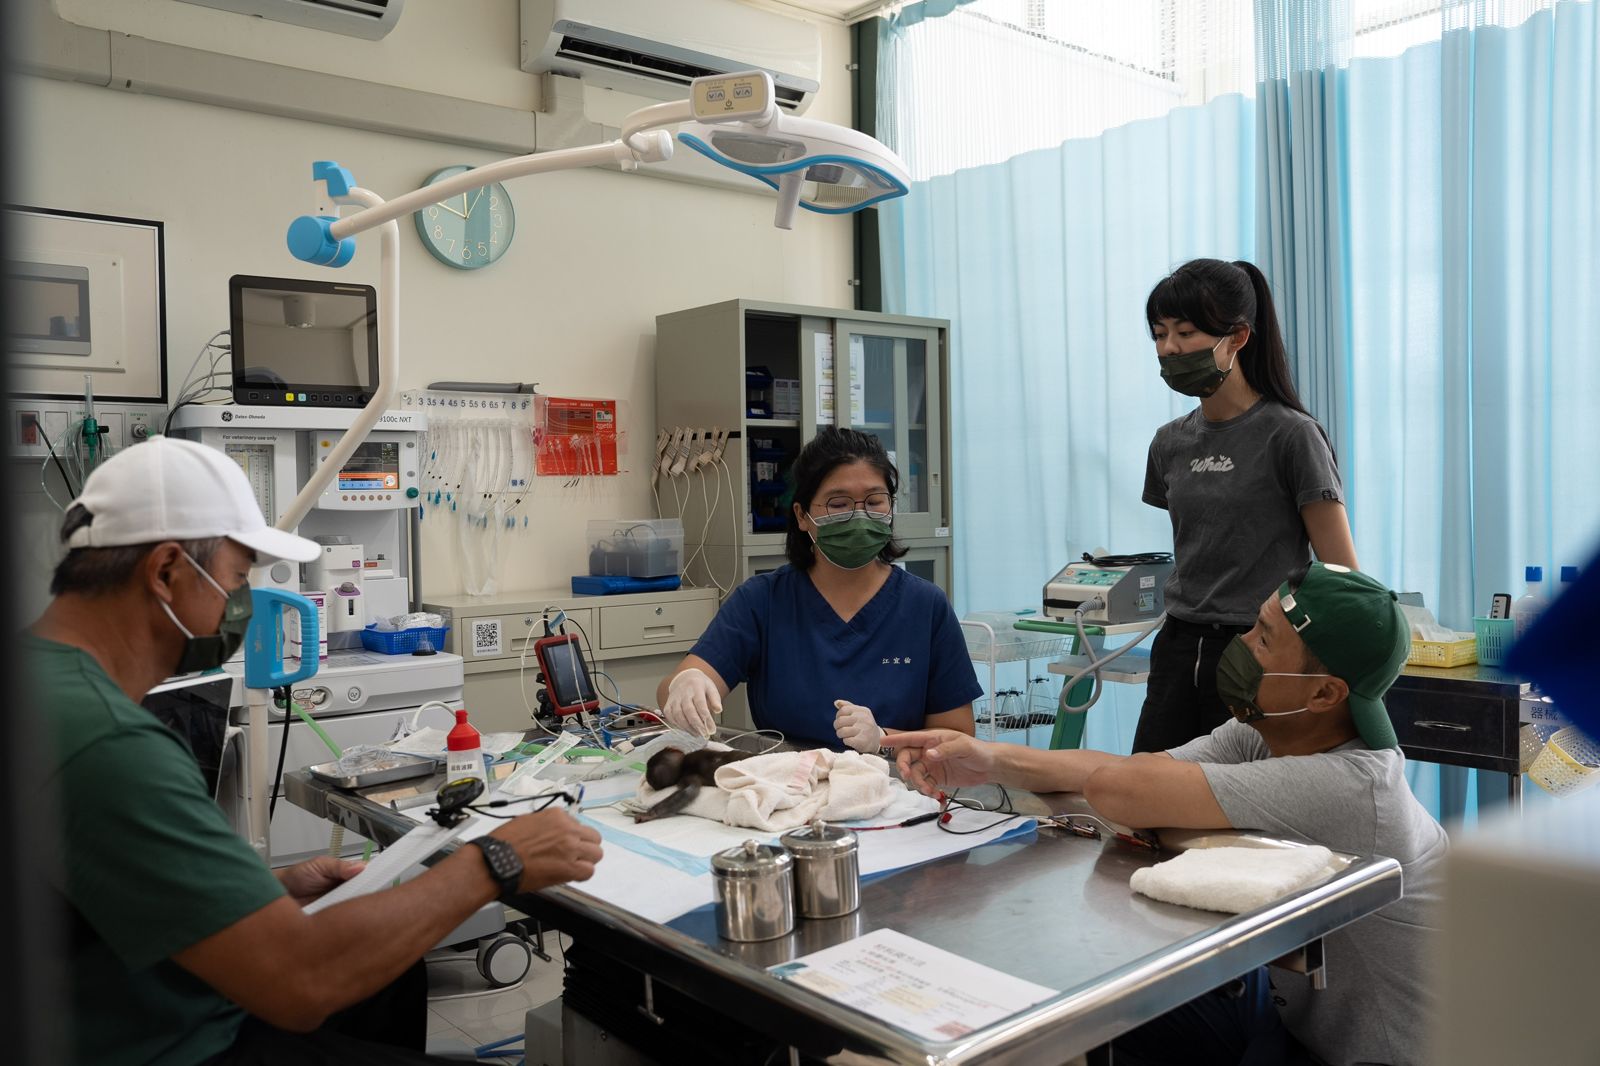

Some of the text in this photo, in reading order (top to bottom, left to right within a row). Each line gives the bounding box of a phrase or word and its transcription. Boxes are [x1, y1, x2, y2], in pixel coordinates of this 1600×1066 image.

[489, 196, 498, 211] 2
[428, 207, 439, 221] 9
[494, 213, 503, 228] 3
[434, 225, 443, 239] 8
[489, 231, 497, 246] 4
[445, 239, 456, 253] 7
[461, 245, 472, 260] 6
[477, 242, 487, 257] 5
[407, 397, 527, 410] 2 3 3.5 4 4.5 5 5.5 6 6.5 7 8 9
